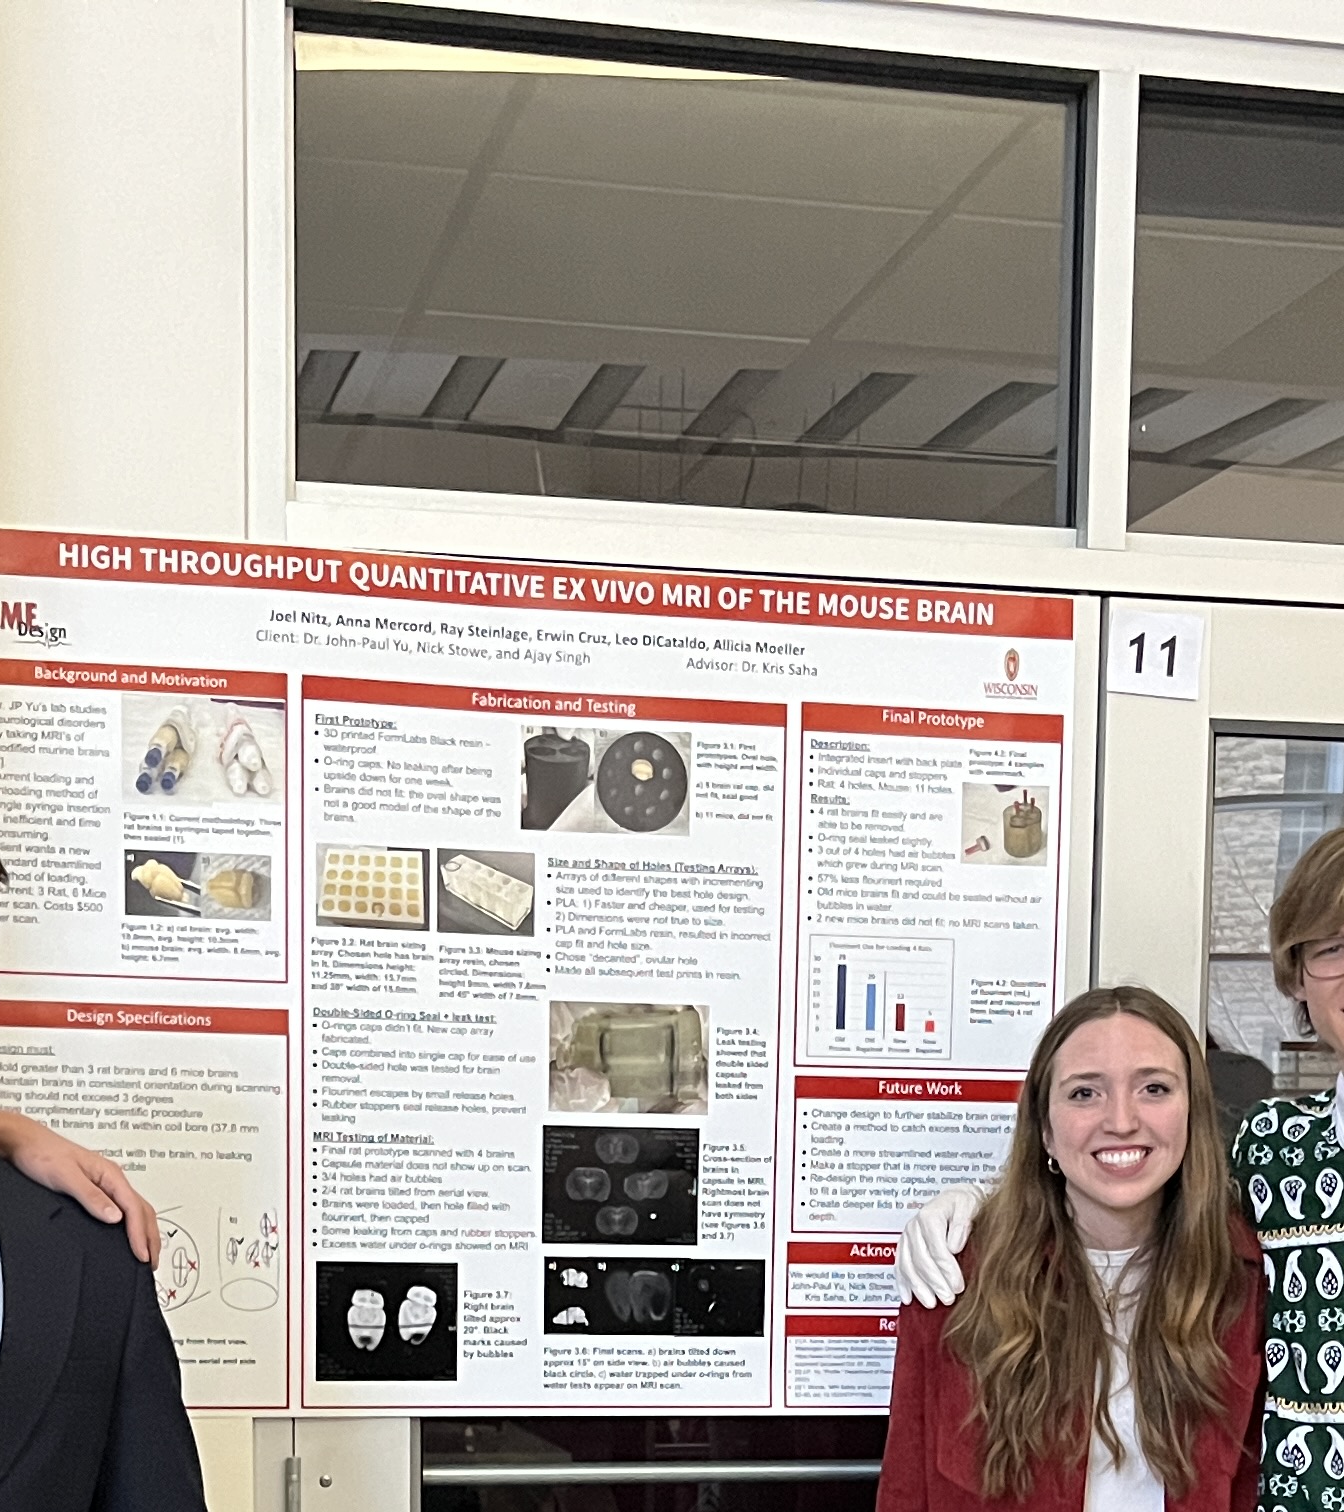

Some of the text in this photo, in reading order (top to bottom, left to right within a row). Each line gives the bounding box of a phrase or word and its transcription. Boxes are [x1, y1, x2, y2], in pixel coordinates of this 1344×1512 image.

[59, 542, 993, 625] HIGH THROUGHPUT QUANTITATIVE EX VIVO MRI OF THE MOUSE BRAIN
[18, 621, 66, 642] Design
[270, 609, 296, 622] Joel
[301, 611, 331, 627] Nitz,
[336, 614, 370, 627] Anna
[375, 617, 435, 635] Mercord,
[440, 622, 463, 638] Ray
[468, 624, 532, 643] Steinlage,
[537, 629, 574, 642] Erwin
[579, 631, 611, 645] Cruz,
[616, 633, 638, 645] Leo
[643, 634, 709, 651] DiCataldo,
[755, 641, 805, 656] Moeller
[325, 633, 389, 650] John-Paul
[416, 640, 444, 654] Nick
[495, 646, 519, 660] and
[523, 648, 551, 664] Ajay
[555, 650, 590, 666] Singh
[1129, 632, 1176, 677] 11
[34, 665, 227, 688] Background and Motivation
[762, 662, 784, 674] Kris
[788, 663, 817, 676] Saha
[983, 682, 1038, 696] WISCONSIN
[471, 691, 635, 717] Fabrication and Testing
[882, 709, 984, 730] Final Prototype
[66, 1008, 211, 1027] Design Specifications
[879, 1080, 962, 1095] Future Work
